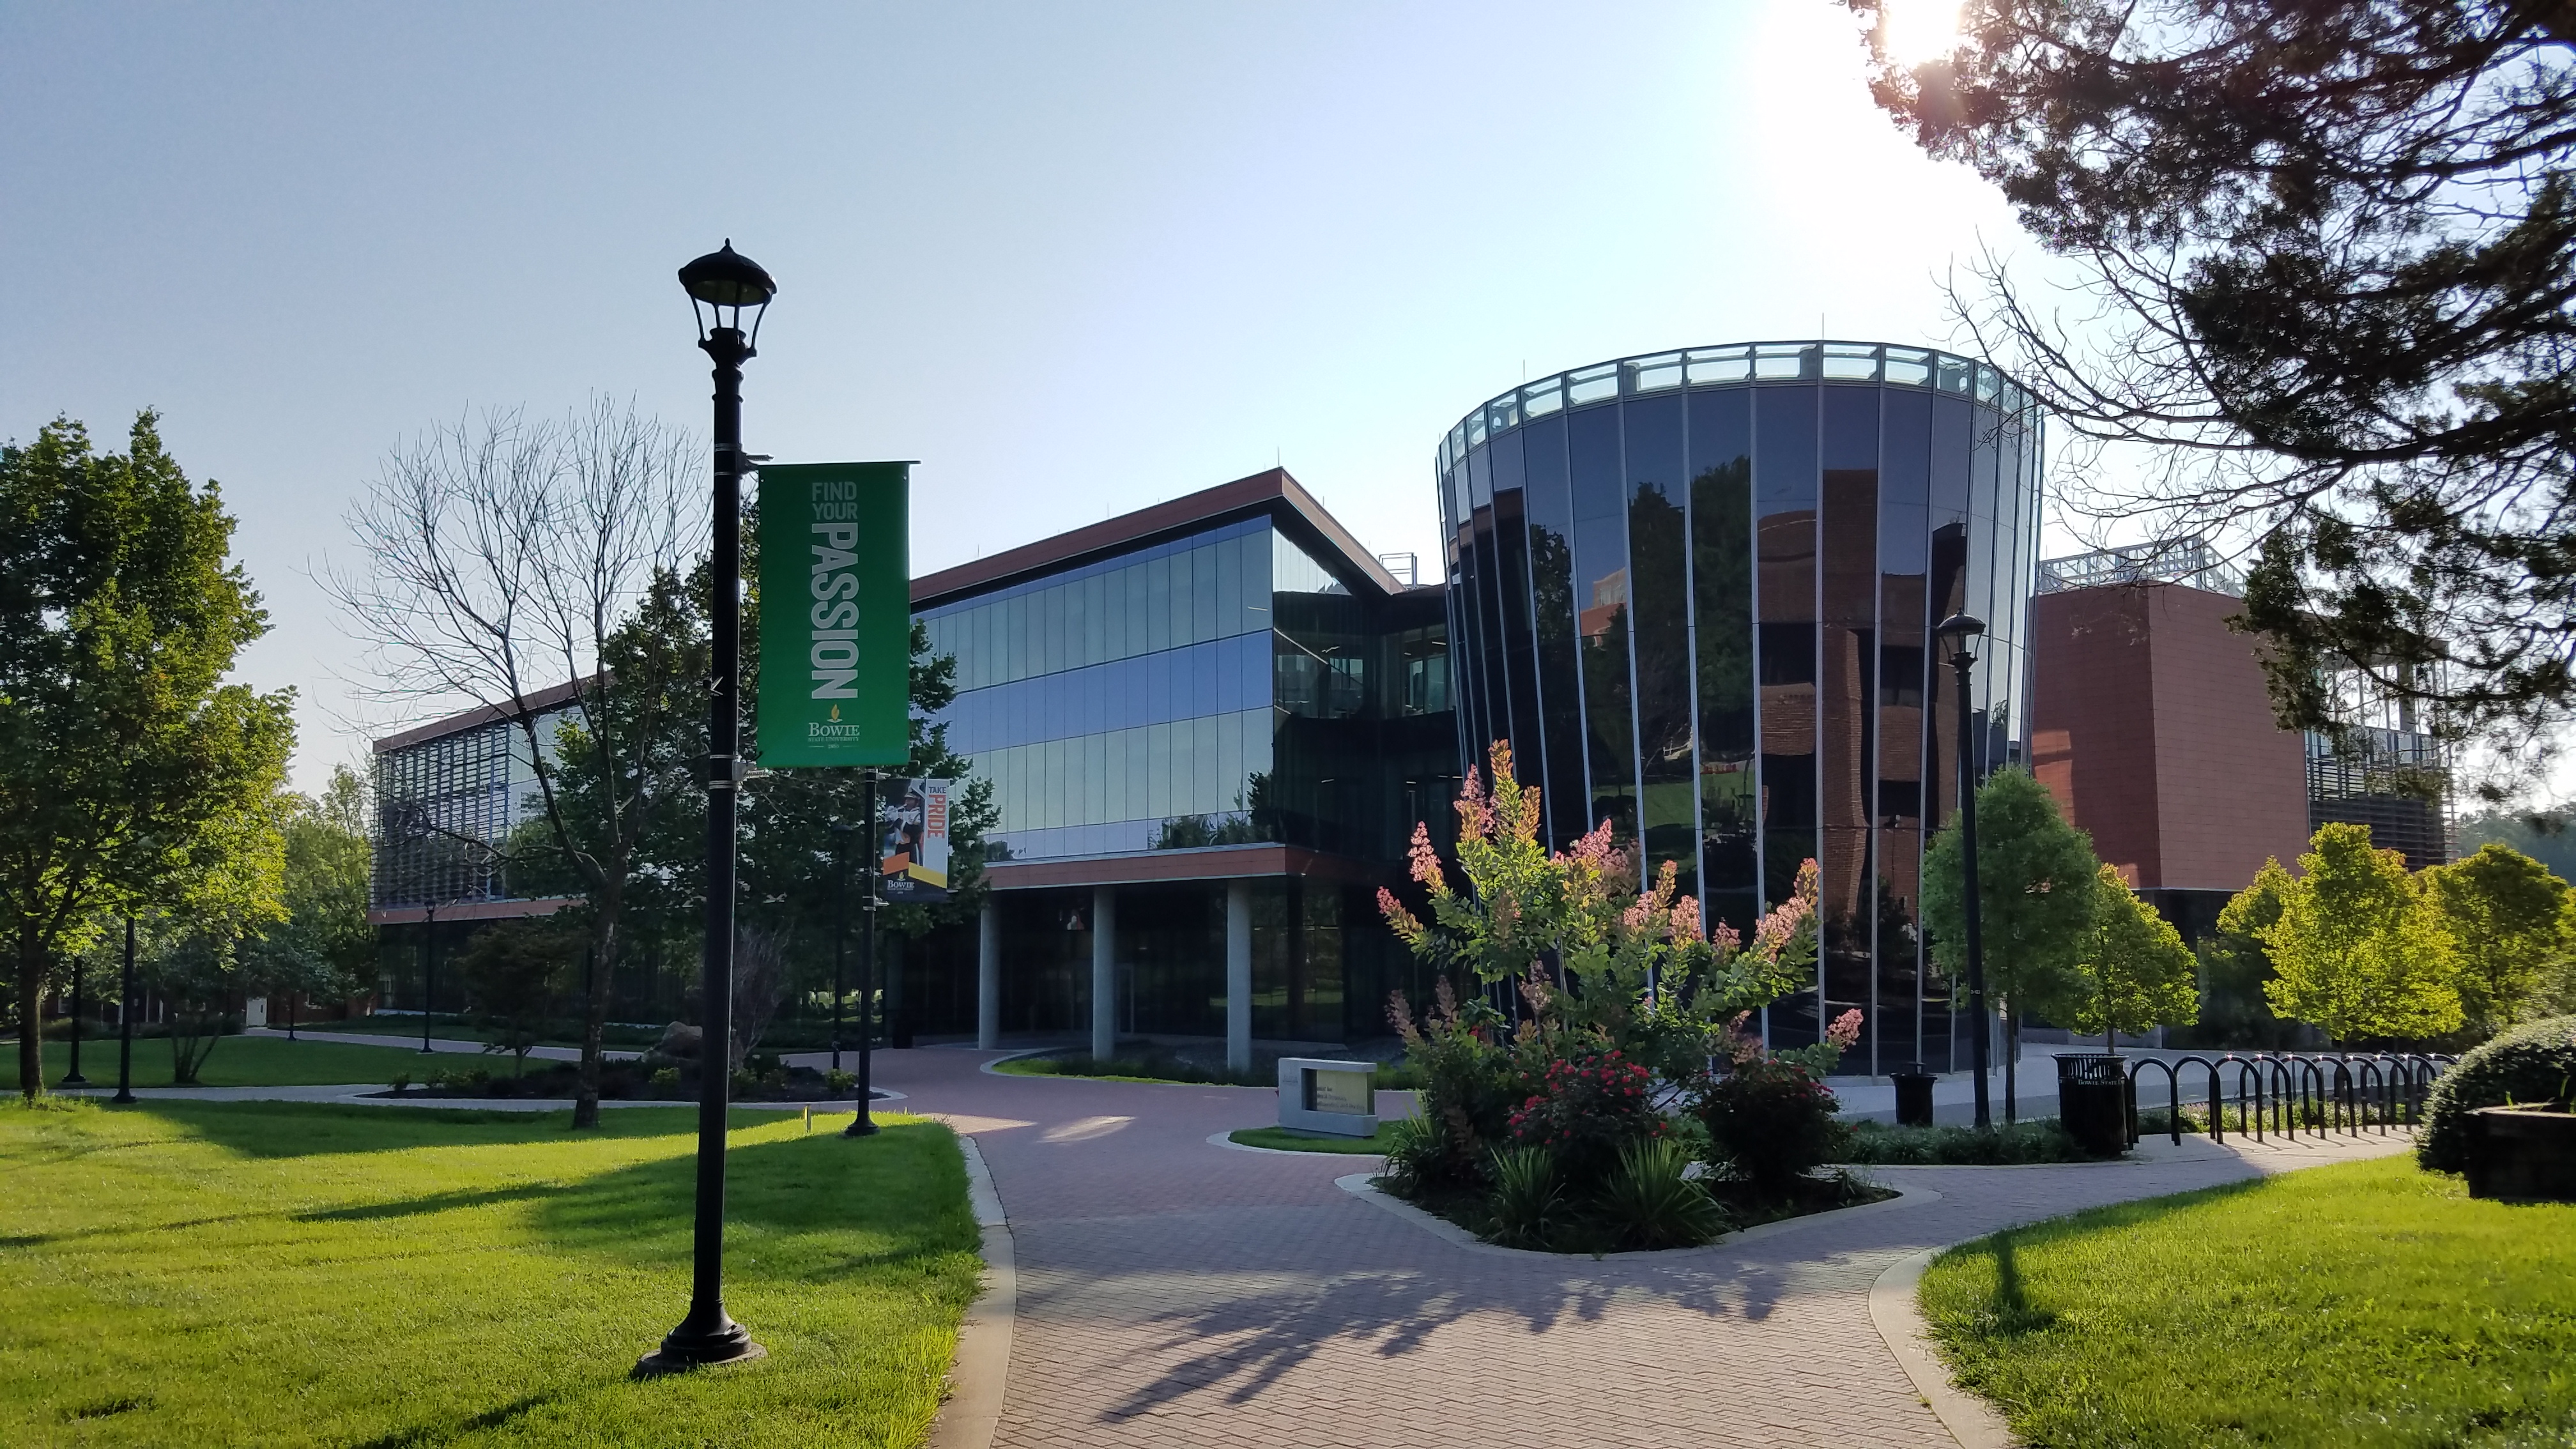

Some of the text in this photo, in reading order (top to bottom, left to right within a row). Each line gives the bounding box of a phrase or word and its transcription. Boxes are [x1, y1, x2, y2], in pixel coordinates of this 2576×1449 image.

[812, 481, 857, 501] FIND
[812, 502, 857, 520] YOUR
[811, 523, 859, 700] PASSION
[927, 794, 946, 839] PRIDE
